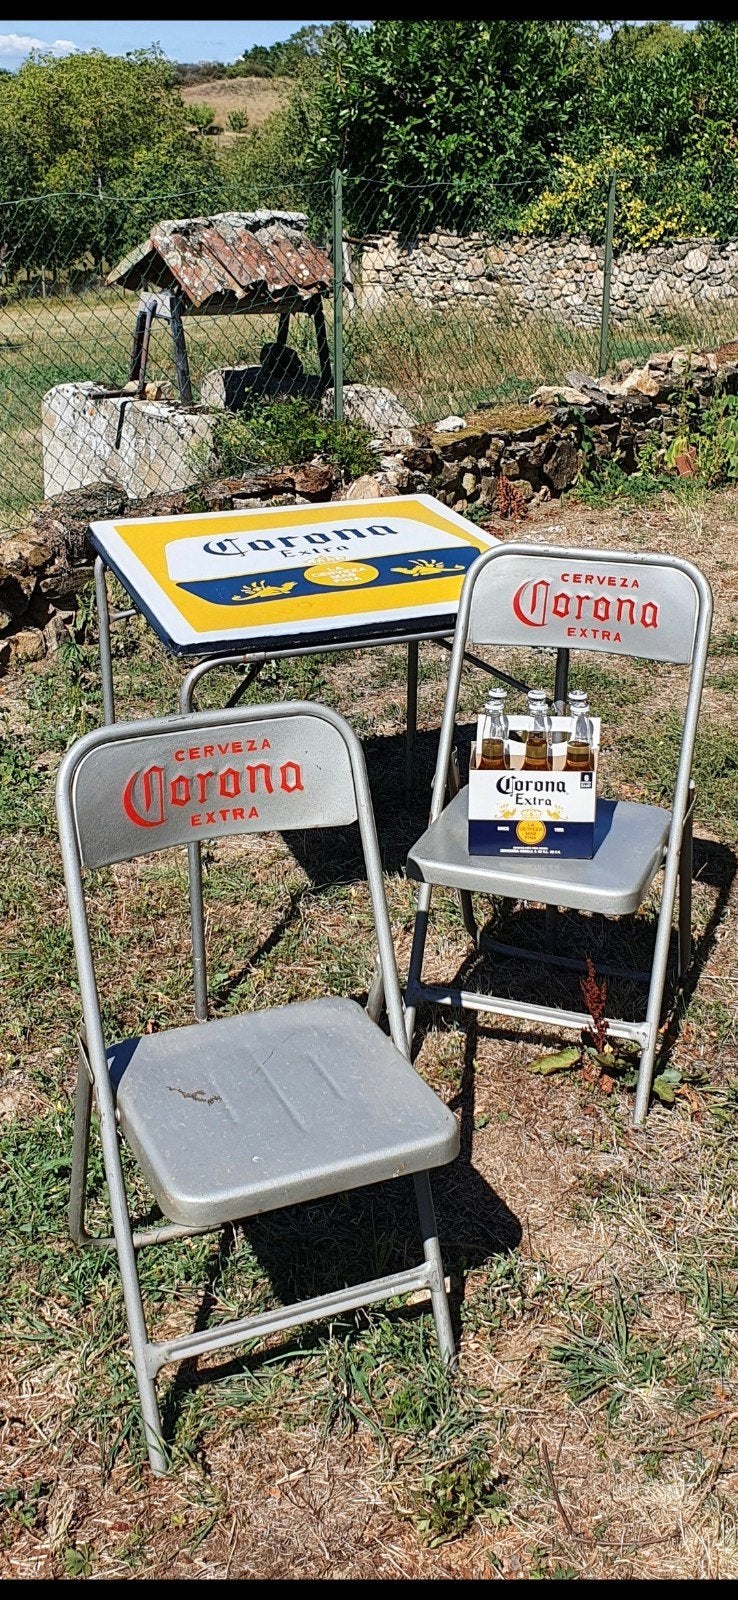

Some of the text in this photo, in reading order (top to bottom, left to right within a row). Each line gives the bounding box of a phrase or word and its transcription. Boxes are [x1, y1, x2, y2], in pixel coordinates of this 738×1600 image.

[203, 525, 399, 557] Corona
[280, 545, 350, 558] Extra
[561, 573, 640, 589] CERVEZA
[513, 579, 660, 629] Corona
[567, 627, 622, 643] EXTRA
[174, 738, 272, 762] CERVEZA
[123, 761, 304, 828] Corona
[496, 775, 567, 797] Corona
[515, 793, 552, 806] Extra
[191, 806, 260, 827] EXTRA
